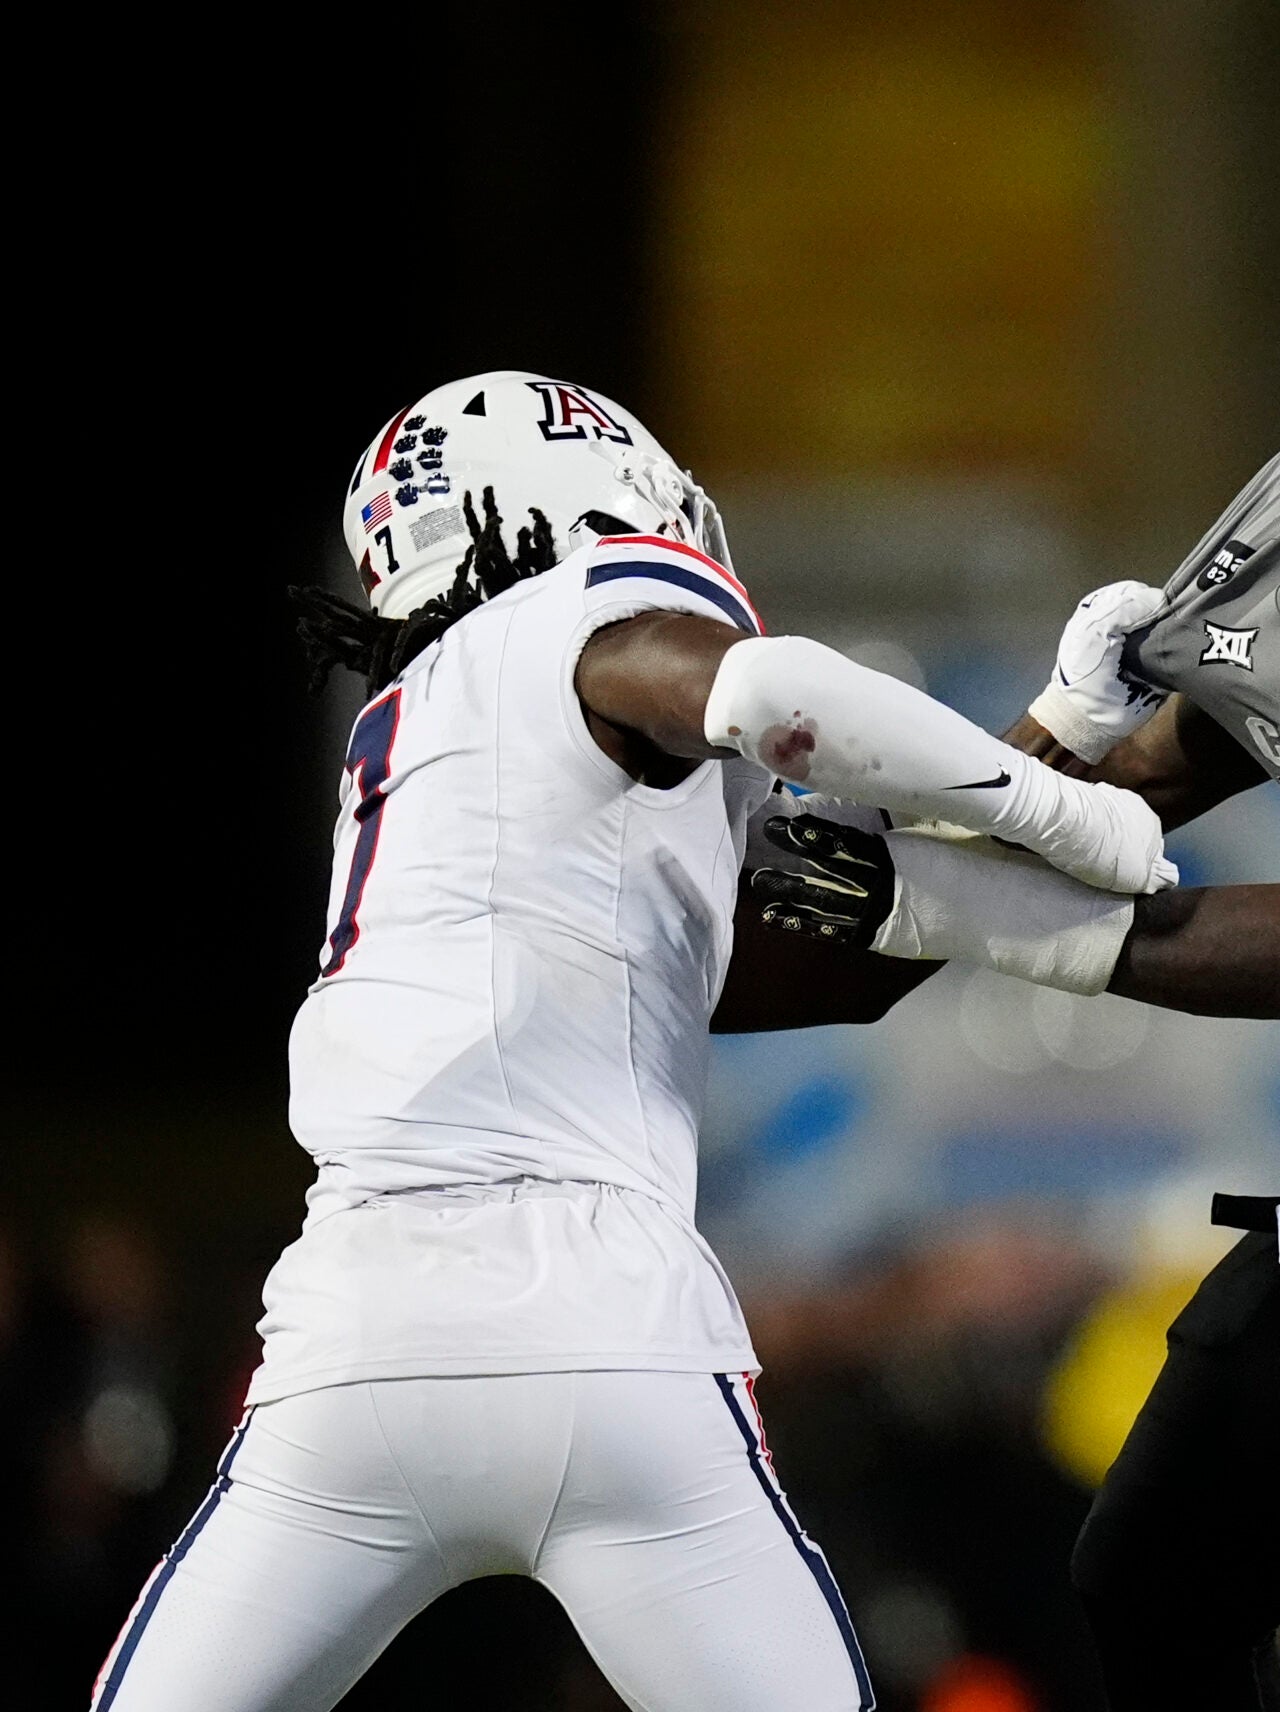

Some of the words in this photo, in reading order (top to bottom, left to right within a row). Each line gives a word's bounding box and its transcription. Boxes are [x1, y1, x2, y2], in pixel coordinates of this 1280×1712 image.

[524, 382, 634, 446] A
[374, 524, 400, 575] 7
[1199, 618, 1261, 673] XII
